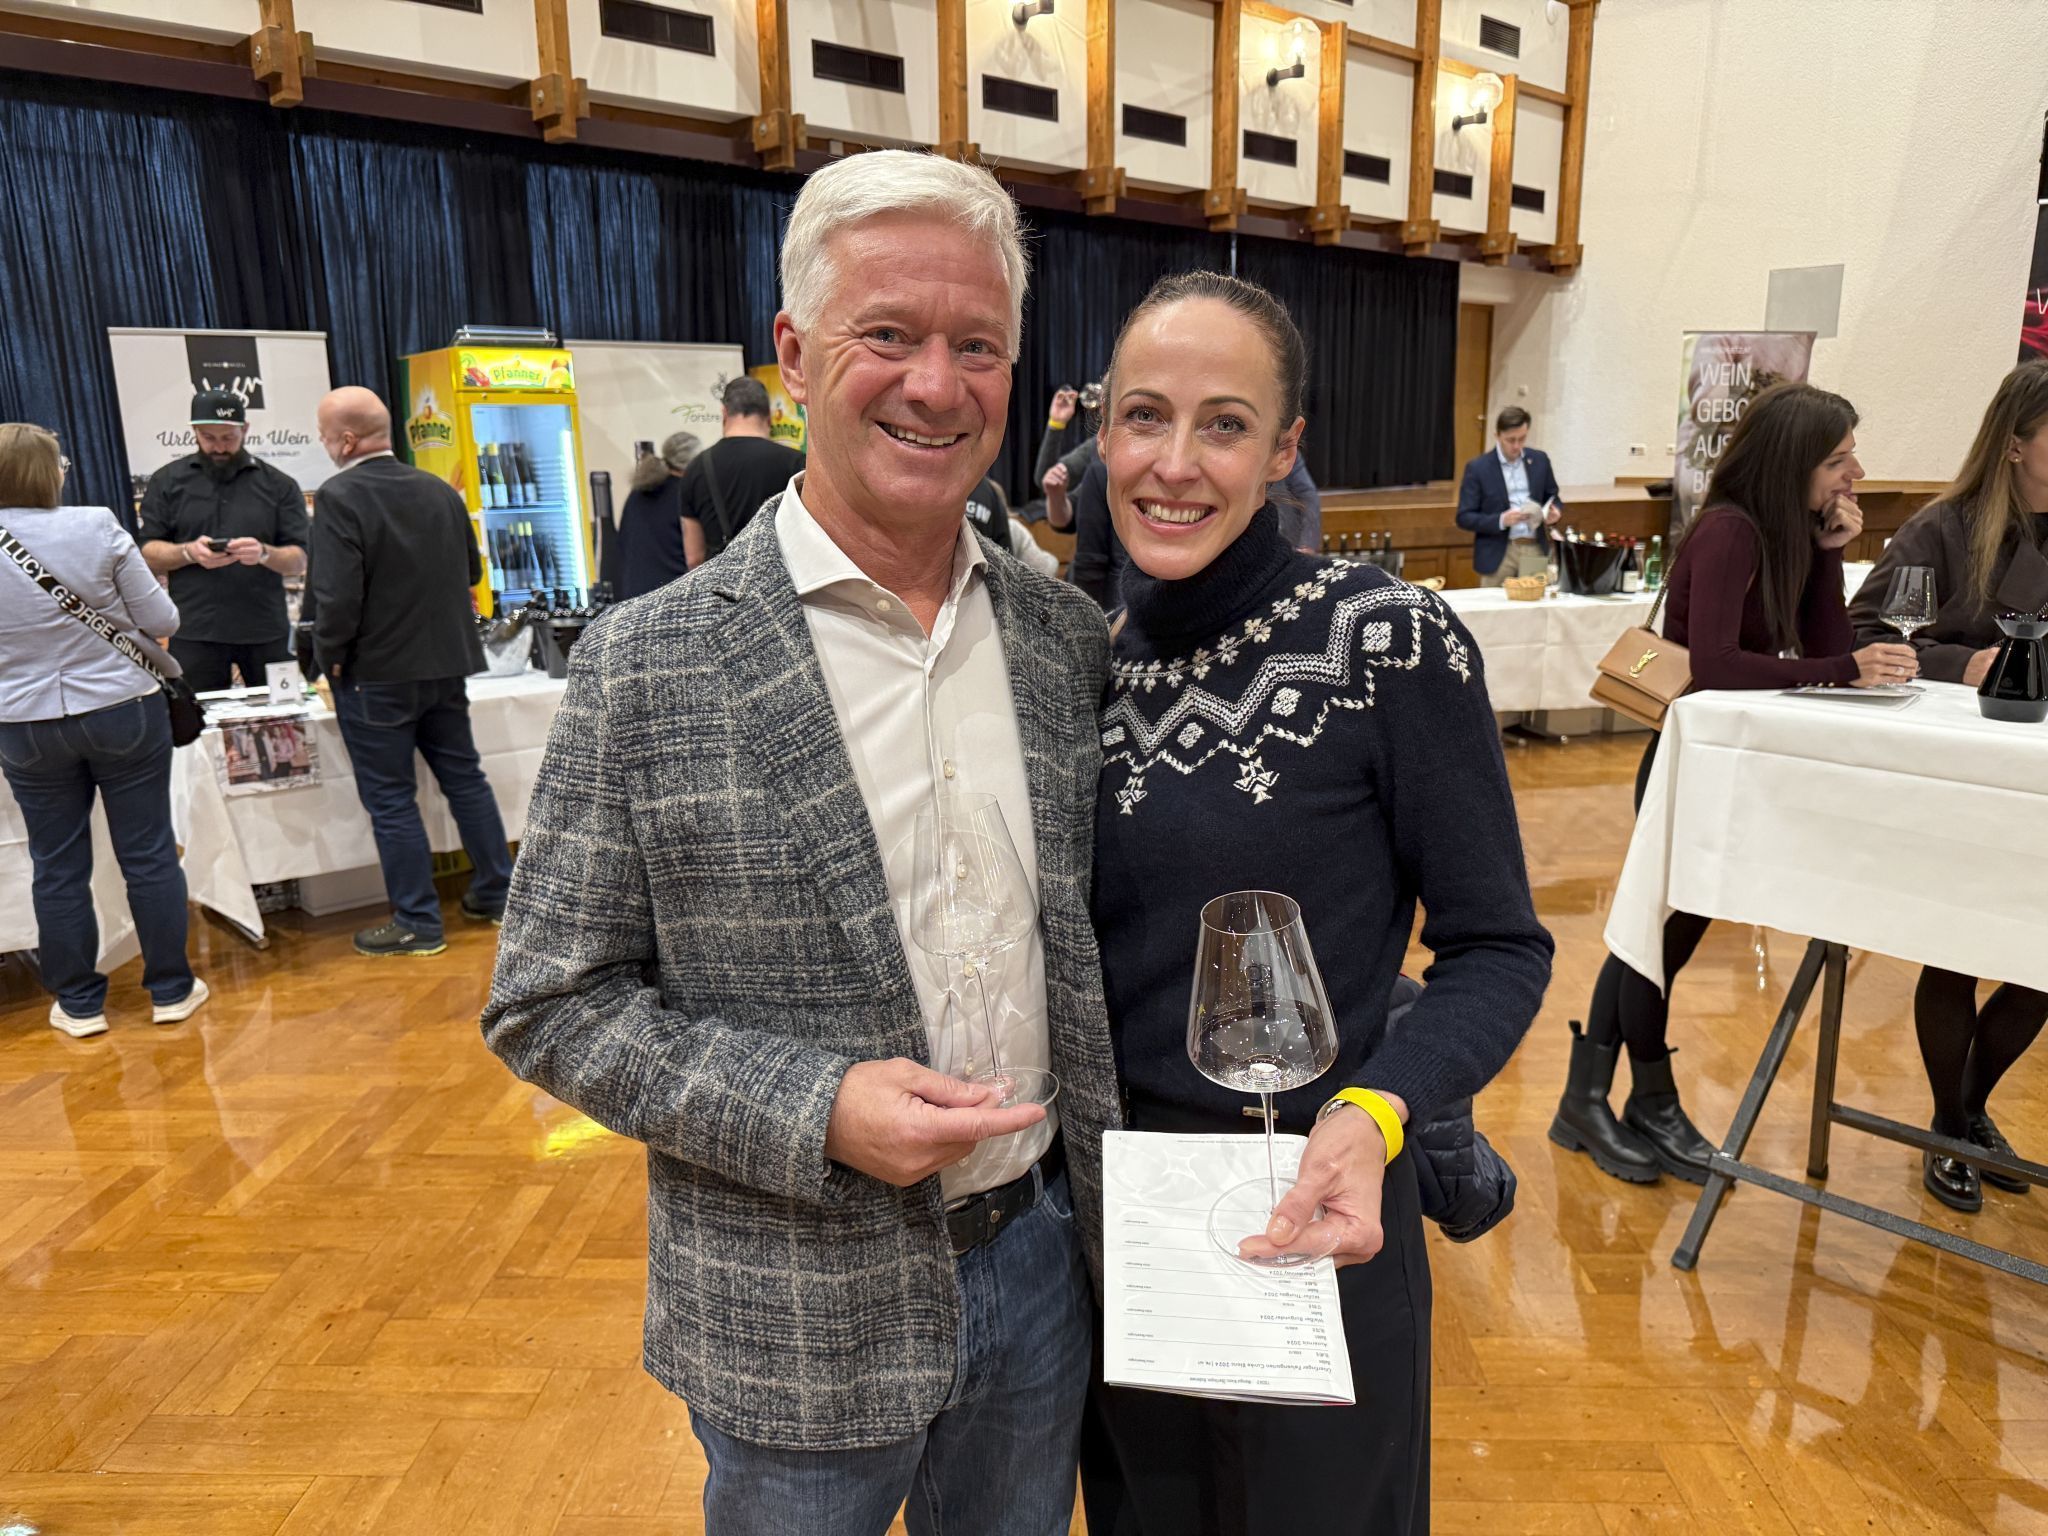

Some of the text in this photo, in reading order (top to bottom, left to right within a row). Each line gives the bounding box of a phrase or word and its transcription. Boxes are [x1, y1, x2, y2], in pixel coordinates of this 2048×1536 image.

[1699, 362, 1755, 390] WEIN,
[671, 403, 720, 424] Forstre
[1697, 398, 1749, 423] GEBO
[156, 430, 198, 446] Urla
[266, 429, 311, 446] Wein
[769, 423, 801, 439] anner
[1, 538, 52, 584] LUCY
[51, 584, 116, 640] GEORGE
[112, 633, 144, 667] GINA
[280, 678, 290, 690] 6
